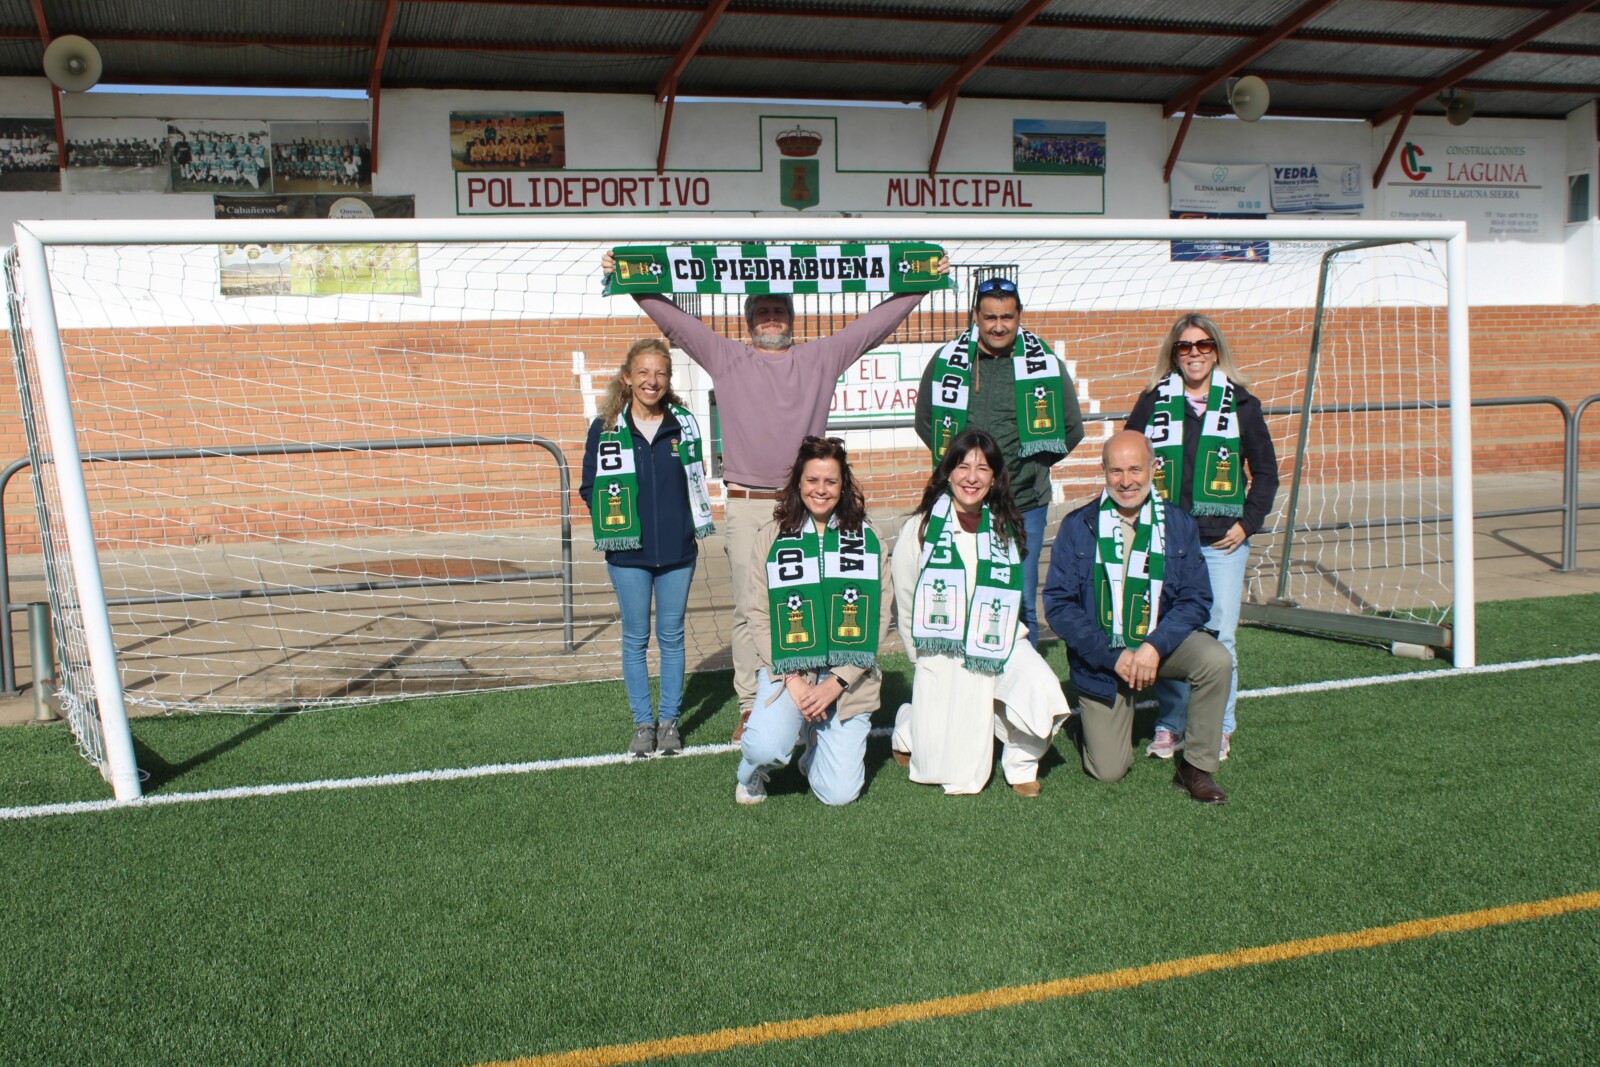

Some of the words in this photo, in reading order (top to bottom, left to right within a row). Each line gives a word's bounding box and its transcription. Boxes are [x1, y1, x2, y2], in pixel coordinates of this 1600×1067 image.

[1446, 145, 1526, 157] CONSTRUCCIONES
[1273, 166, 1318, 180] YEDRA
[1447, 162, 1528, 183] LAGUNA
[467, 176, 710, 208] POLIDEPORTIVO
[887, 178, 1033, 208] MUNICIPAL
[1408, 188, 1432, 199] JOSÉ
[1432, 189, 1451, 199] LUIS
[1453, 189, 1488, 199] LAGUNA
[1489, 190, 1520, 199] SIERRA
[226, 205, 276, 215] Cabañeros
[673, 258, 706, 281] CD
[712, 256, 886, 281] PIEDRABUENA
[859, 358, 887, 381] EL
[941, 374, 963, 404] CD
[600, 441, 622, 471] CD
[778, 549, 804, 581] CD
